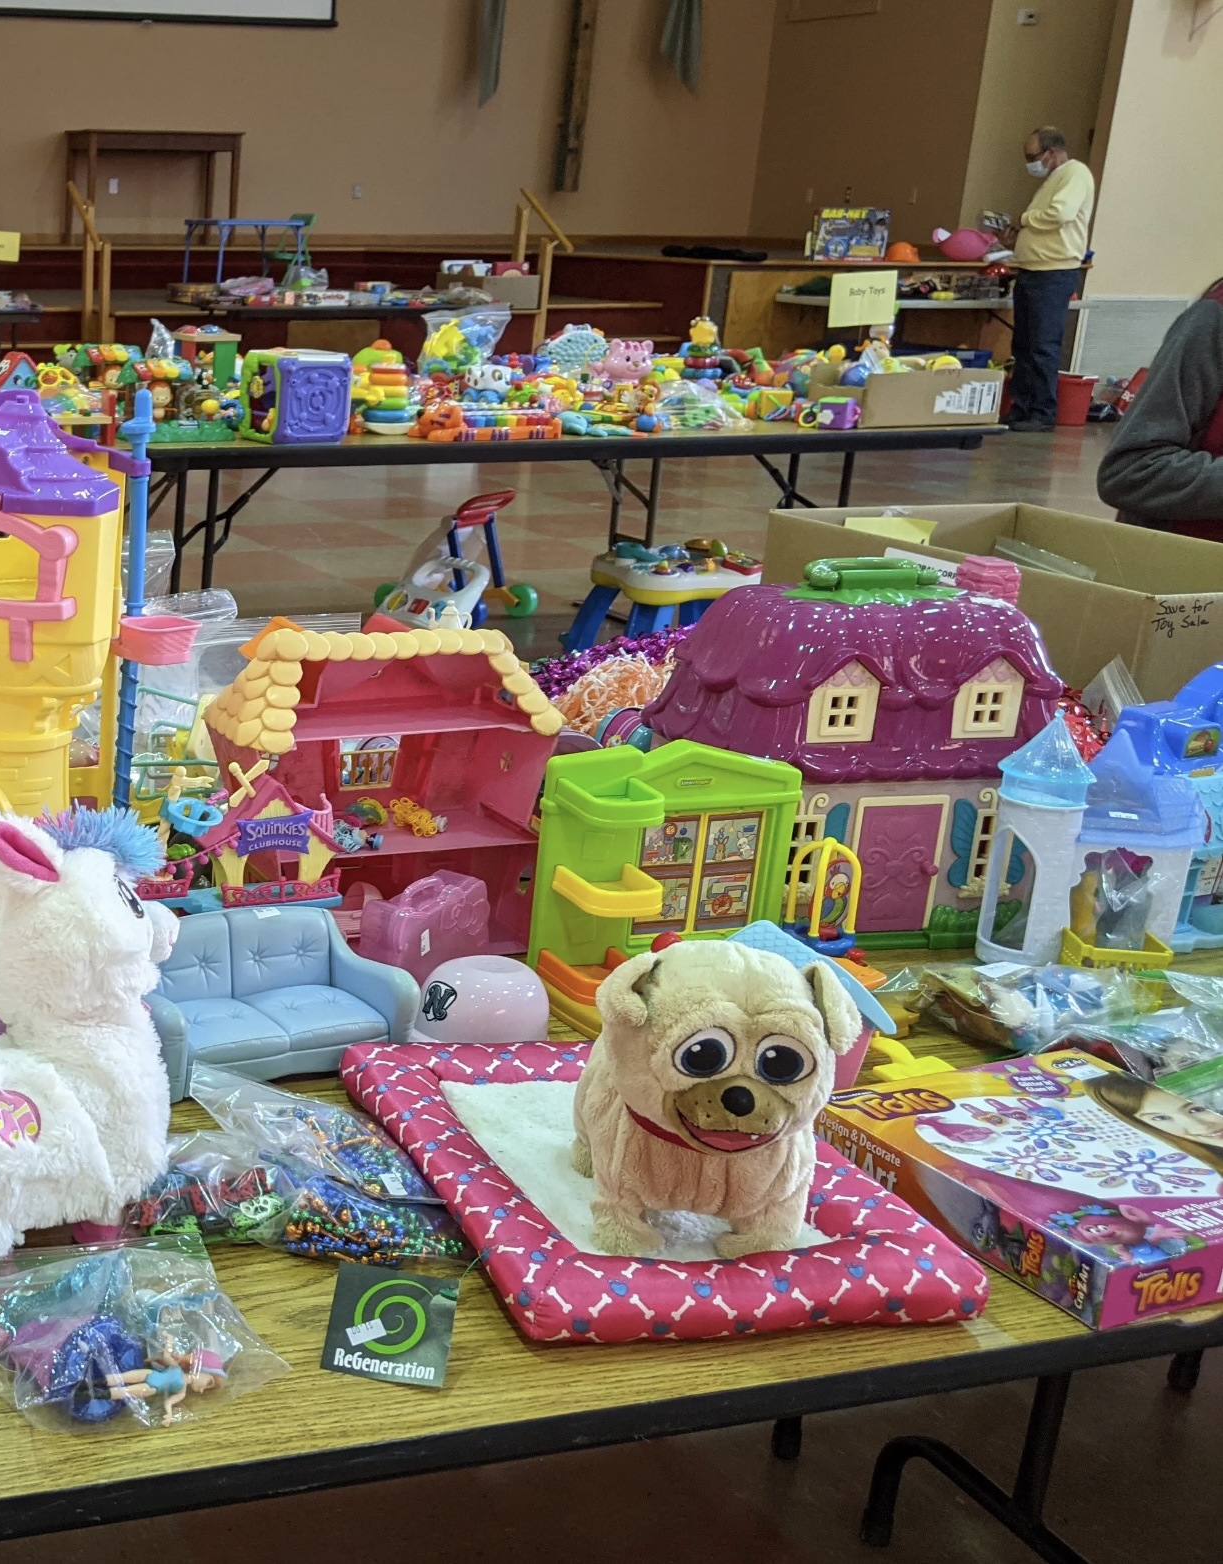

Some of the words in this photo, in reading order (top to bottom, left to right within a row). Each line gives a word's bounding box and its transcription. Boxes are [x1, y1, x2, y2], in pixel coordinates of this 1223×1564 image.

[849, 287, 866, 297] Baby
[869, 286, 886, 296] Toys
[1156, 600, 1186, 615] Save
[1192, 599, 1214, 614] for
[1151, 616, 1175, 638] Toy
[1181, 614, 1210, 628] Sale
[248, 839, 303, 851] CLUBHOUSE
[819, 1111, 850, 1138] Design
[850, 1129, 859, 1143] &
[859, 1132, 901, 1167] Decorate
[1151, 1208, 1189, 1218] Design
[333, 1347, 435, 1380] ReGeneration
